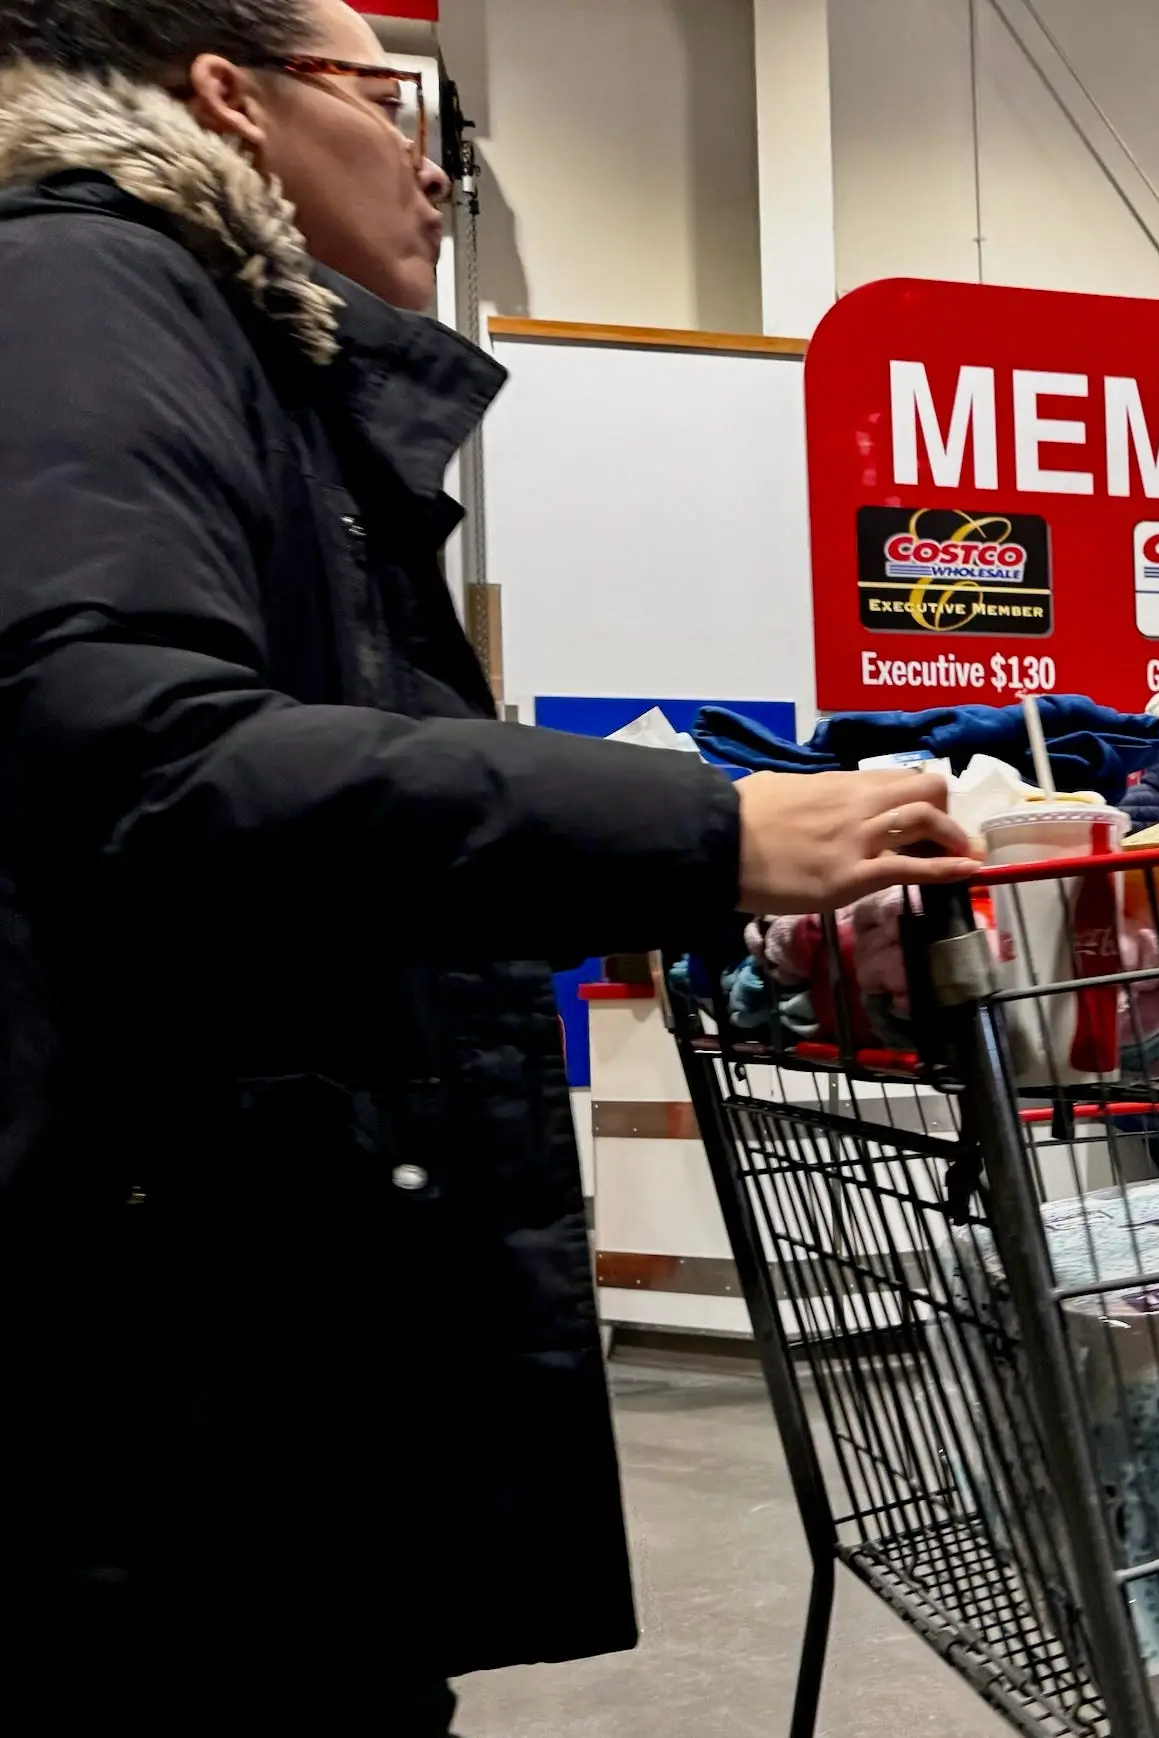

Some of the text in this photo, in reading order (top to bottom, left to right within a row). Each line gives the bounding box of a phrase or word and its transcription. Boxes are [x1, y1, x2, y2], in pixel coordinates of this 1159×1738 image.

[886, 534, 1026, 568] COSTCO
[931, 566, 1023, 580] WHOLESALE
[971, 602, 1044, 618] MEMBER
[861, 650, 1056, 693] Executive $130
